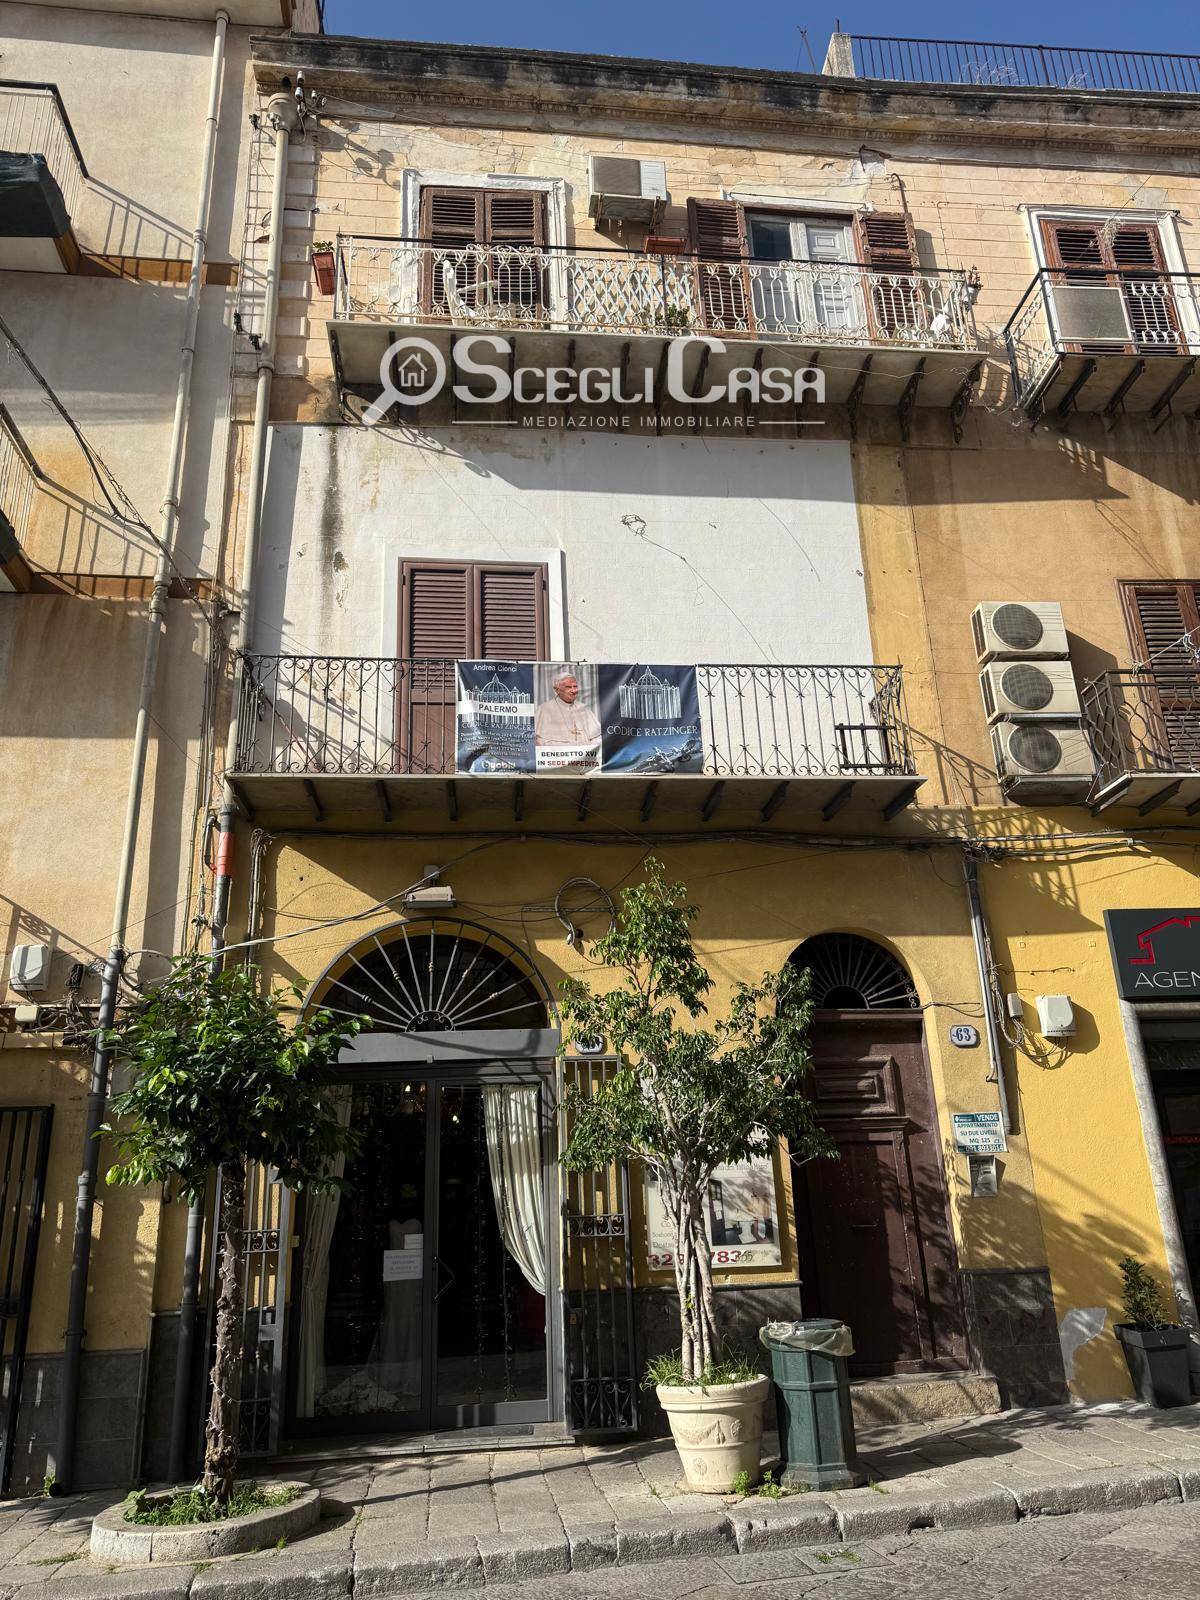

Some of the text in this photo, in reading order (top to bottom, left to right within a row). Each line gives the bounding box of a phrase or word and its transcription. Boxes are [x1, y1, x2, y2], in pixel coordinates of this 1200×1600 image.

[478, 703, 518, 714] PALERMO
[606, 725, 698, 737] CODICE RATZINGER
[585, 750, 597, 758] XVI
[955, 1027, 972, 1042] 63
